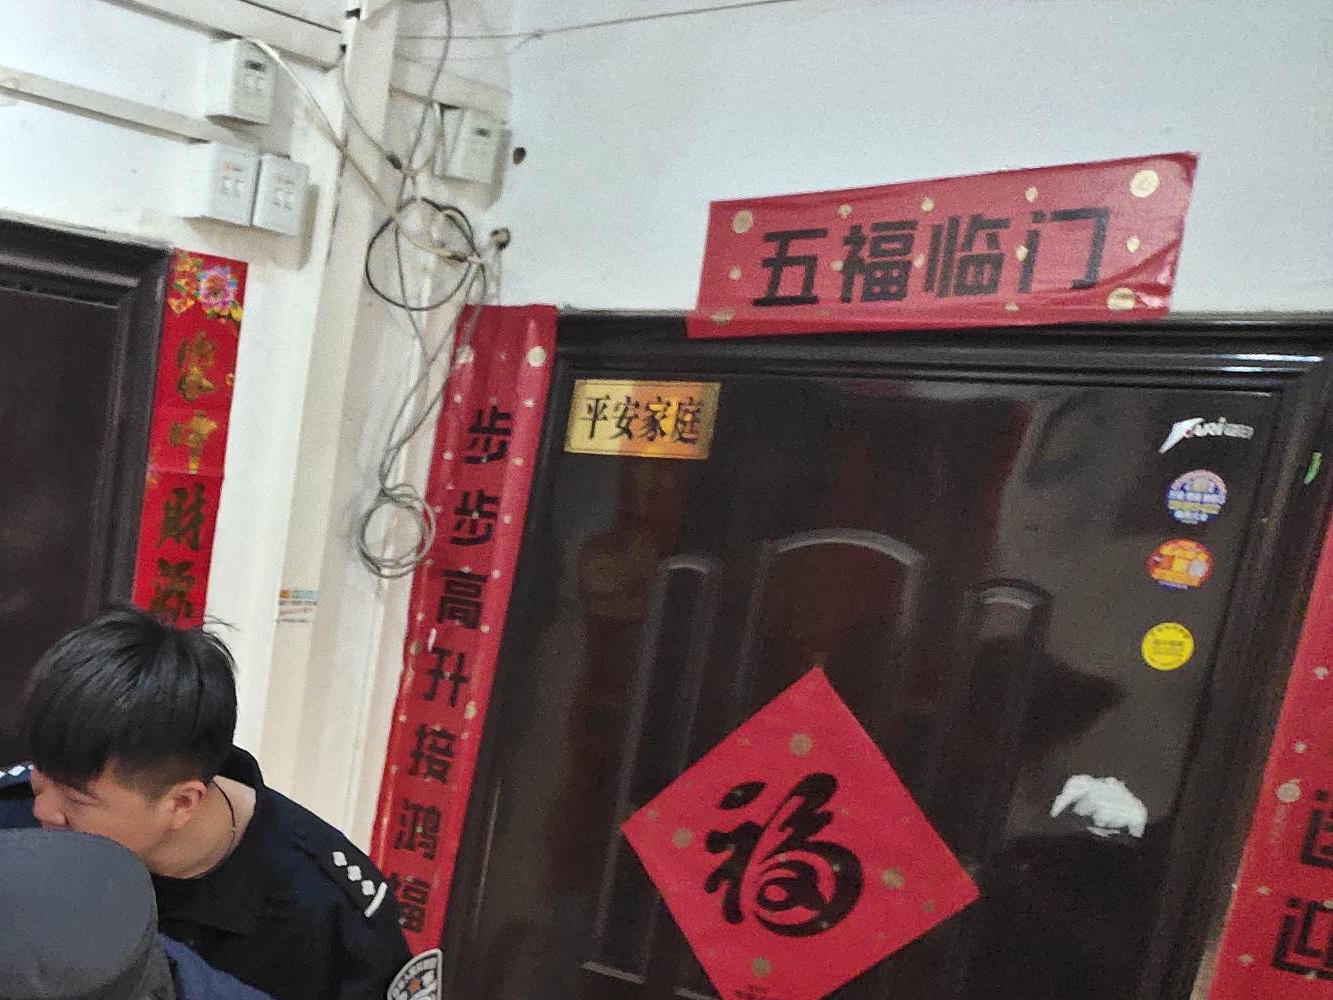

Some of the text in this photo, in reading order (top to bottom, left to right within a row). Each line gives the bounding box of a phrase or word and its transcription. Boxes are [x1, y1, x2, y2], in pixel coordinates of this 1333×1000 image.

[753, 206, 1110, 307] 五福临门
[705, 772, 864, 938] 福
